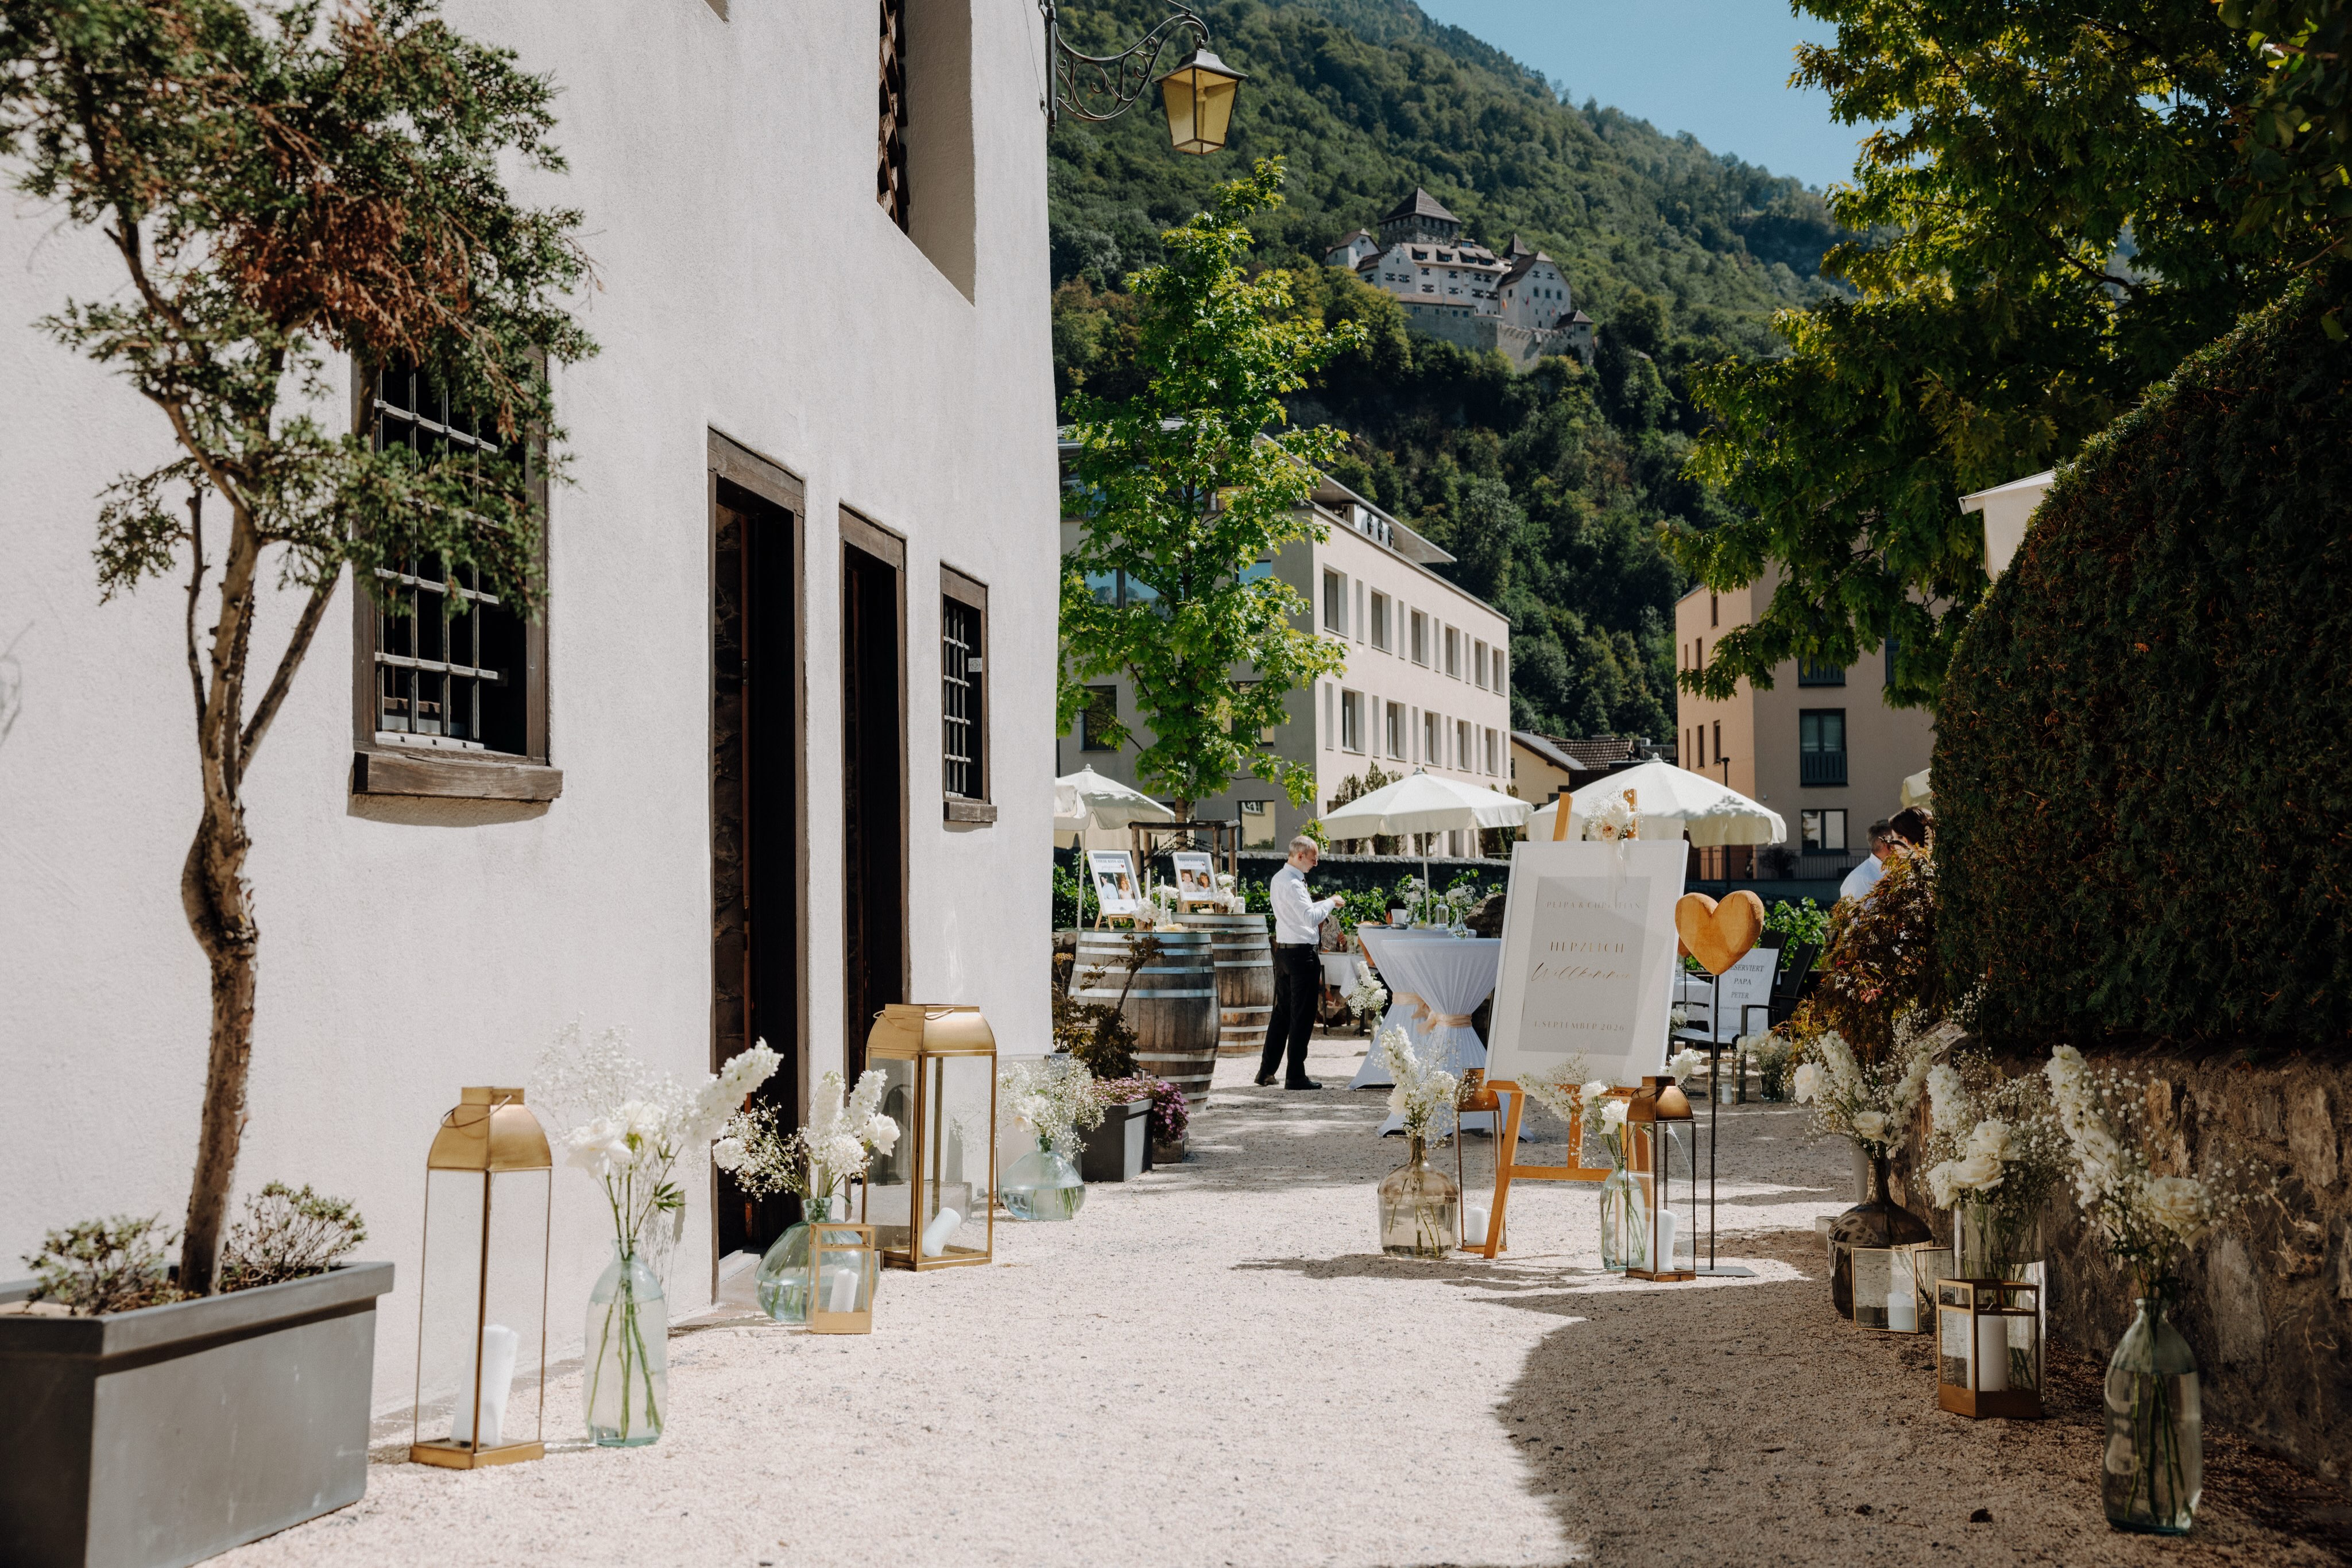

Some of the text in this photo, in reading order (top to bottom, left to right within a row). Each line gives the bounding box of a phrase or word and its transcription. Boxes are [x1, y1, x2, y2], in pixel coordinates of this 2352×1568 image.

[1587, 901, 1641, 909] CHRITIAN
[1550, 941, 1623, 953] HERZLICH
[1531, 962, 1631, 981] Willkommen
[1730, 964, 1765, 973] ESERVIERT
